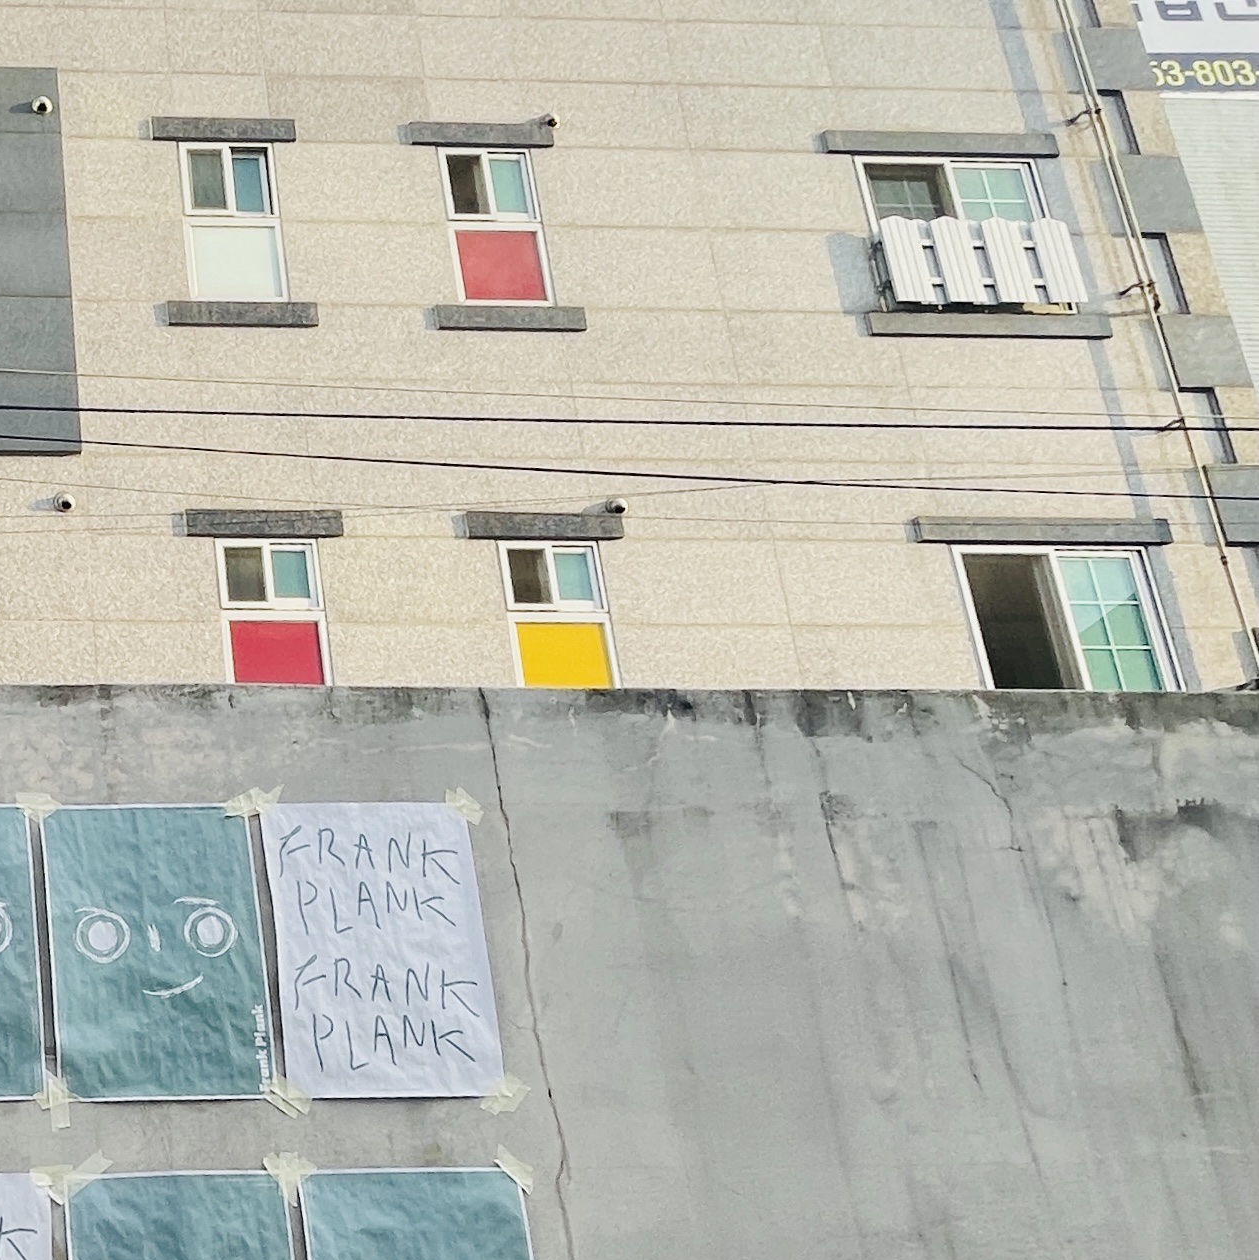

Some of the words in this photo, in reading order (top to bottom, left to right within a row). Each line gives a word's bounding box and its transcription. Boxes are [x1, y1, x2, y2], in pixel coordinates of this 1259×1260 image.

[279, 825, 460, 885] FRANK
[296, 880, 457, 936] PLANK
[294, 954, 481, 1018] FRANK
[250, 1003, 268, 1047] Plank
[312, 1013, 476, 1073] PLANK
